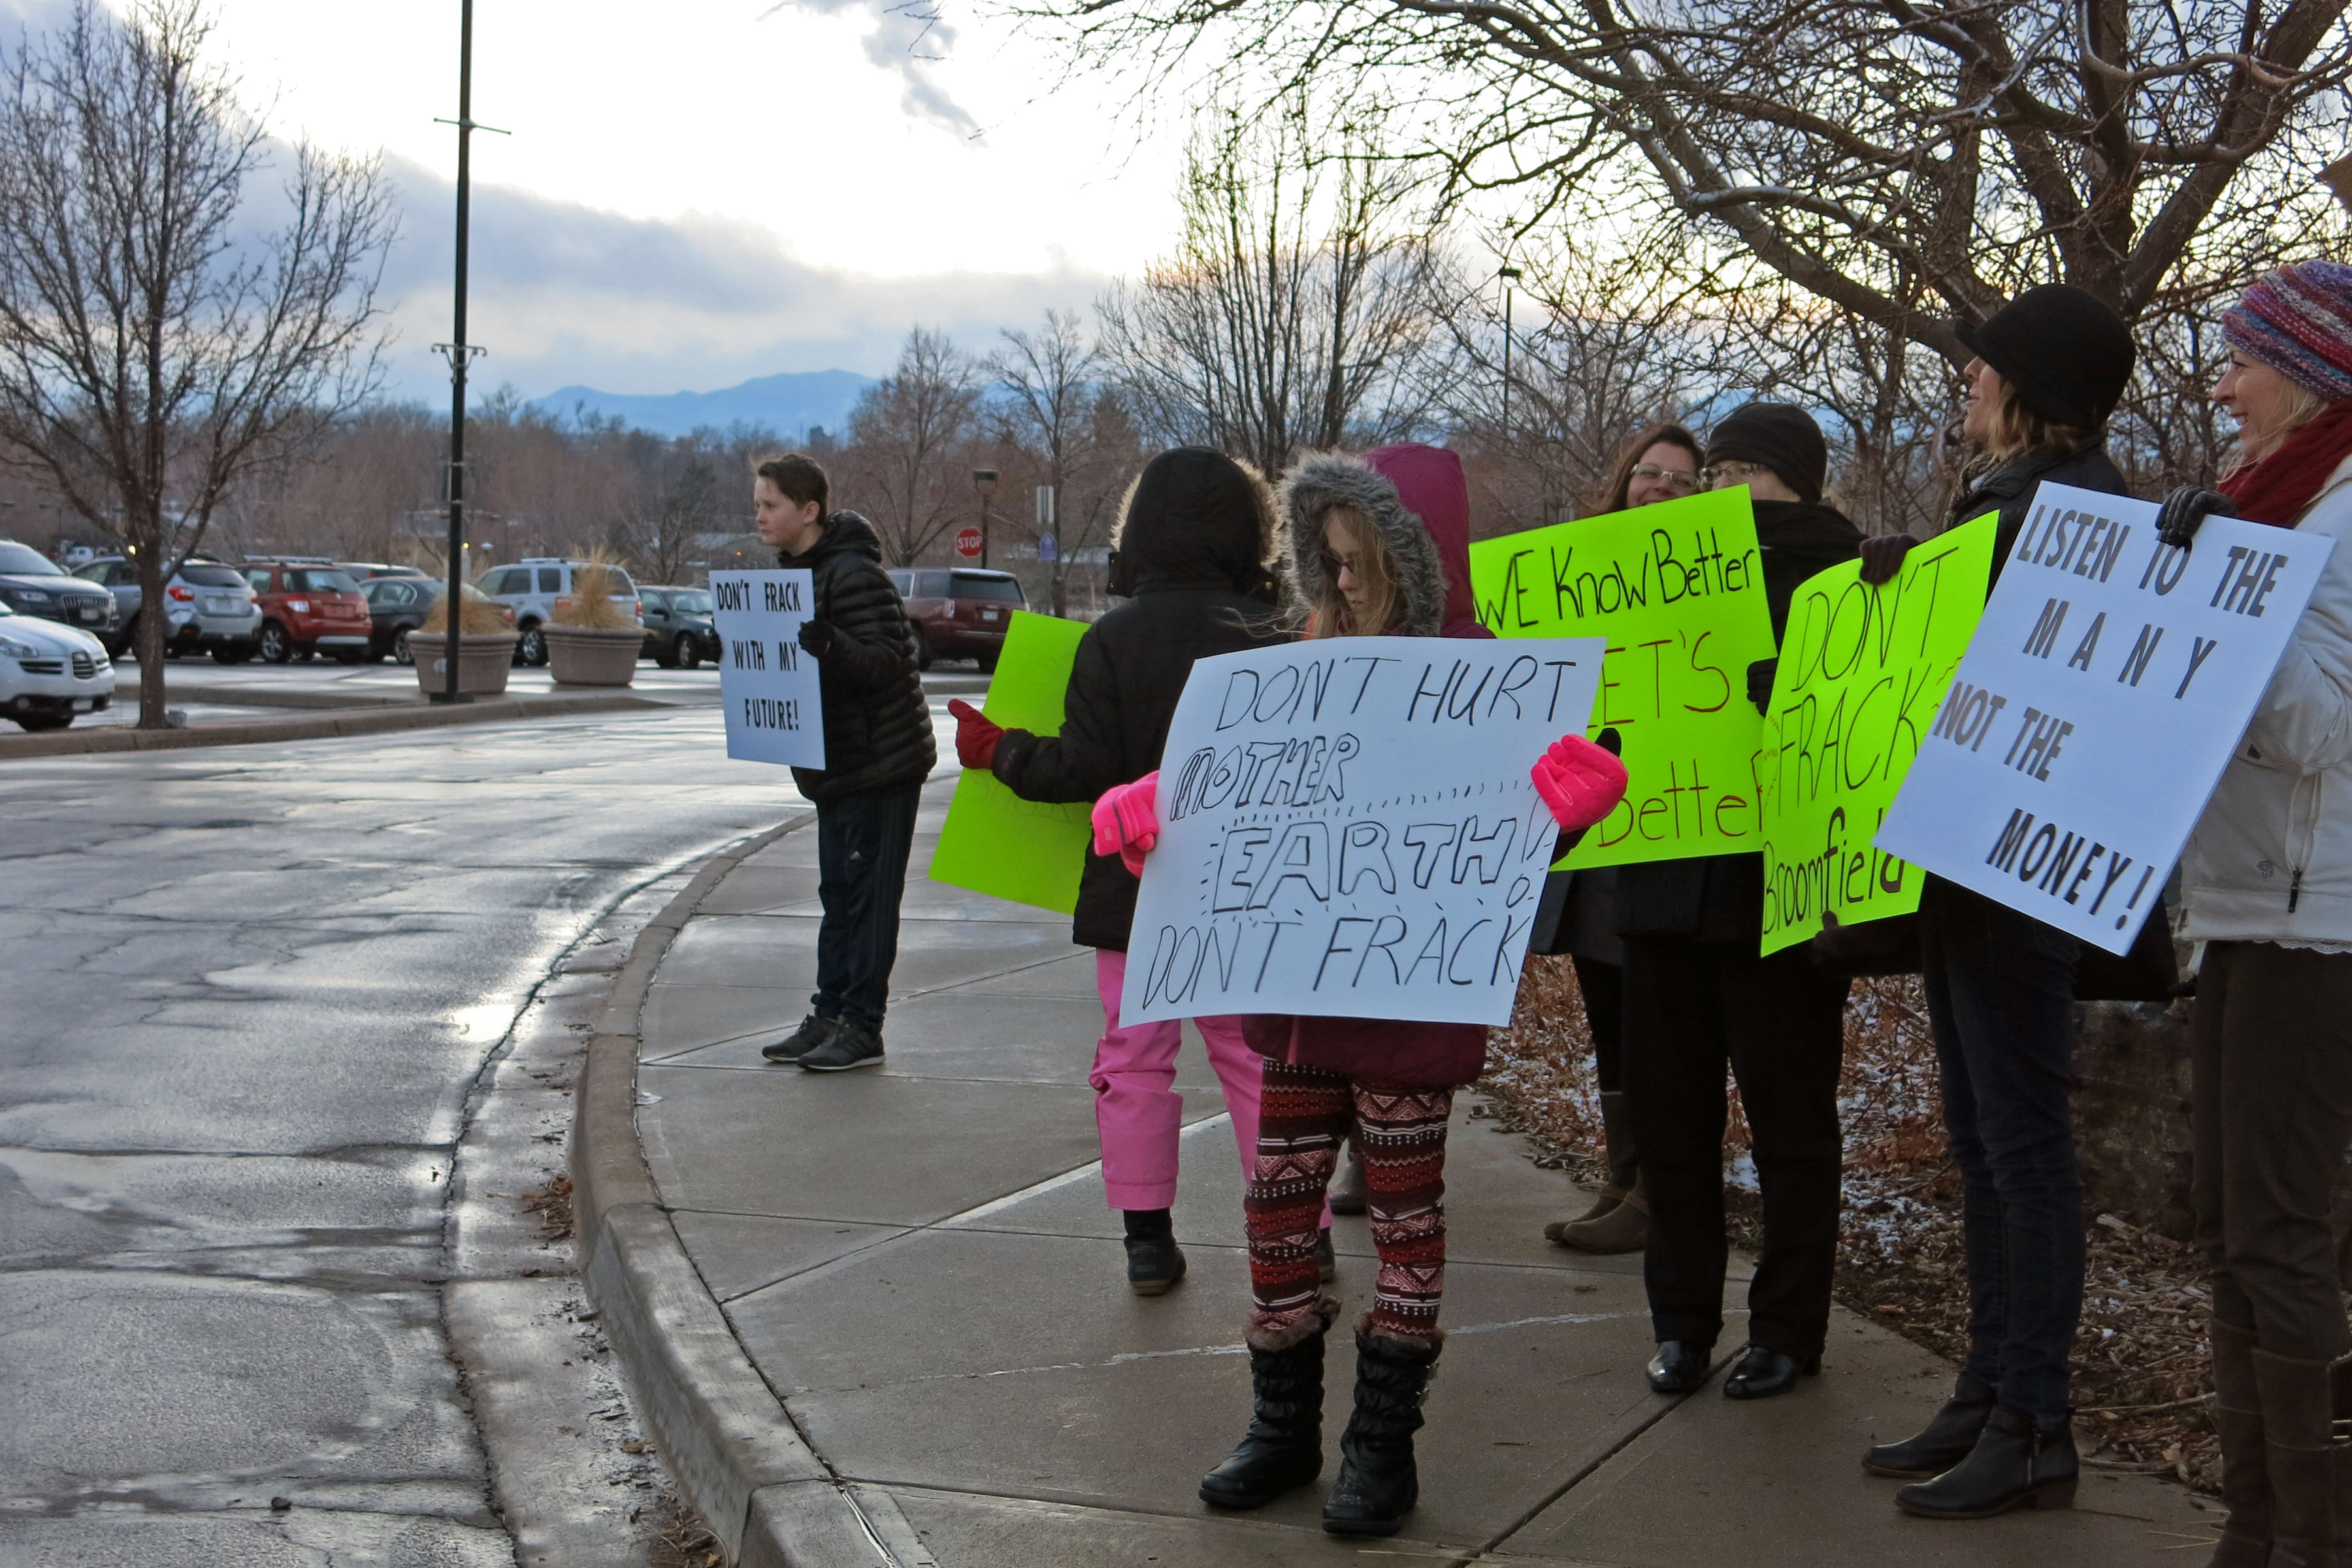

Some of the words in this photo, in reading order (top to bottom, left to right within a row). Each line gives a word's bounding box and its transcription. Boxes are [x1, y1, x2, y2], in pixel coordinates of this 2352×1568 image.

[958, 536, 983, 549] STOP
[1473, 549, 1539, 631] WE
[1652, 526, 1755, 604] Better
[2016, 504, 2131, 583] LISTEN
[2138, 531, 2191, 596] TO
[2210, 545, 2289, 617] THE
[716, 579, 751, 612] DON'T
[764, 581, 801, 612] FRACK
[1791, 547, 1959, 692] DON'T
[732, 640, 765, 670] WITH
[779, 642, 797, 671] MY
[1215, 657, 1402, 732] DON'T
[1407, 655, 1576, 726] HURT
[1587, 629, 1730, 727] ET'S
[744, 698, 799, 731] FUTURE!
[1778, 663, 1932, 817] FRACK
[1933, 681, 2006, 752] NOT
[2004, 706, 2074, 782] THE
[1169, 733, 1360, 821] MOTHER
[1985, 808, 2155, 930] MONEY!
[1313, 915, 1531, 991] FRACK
